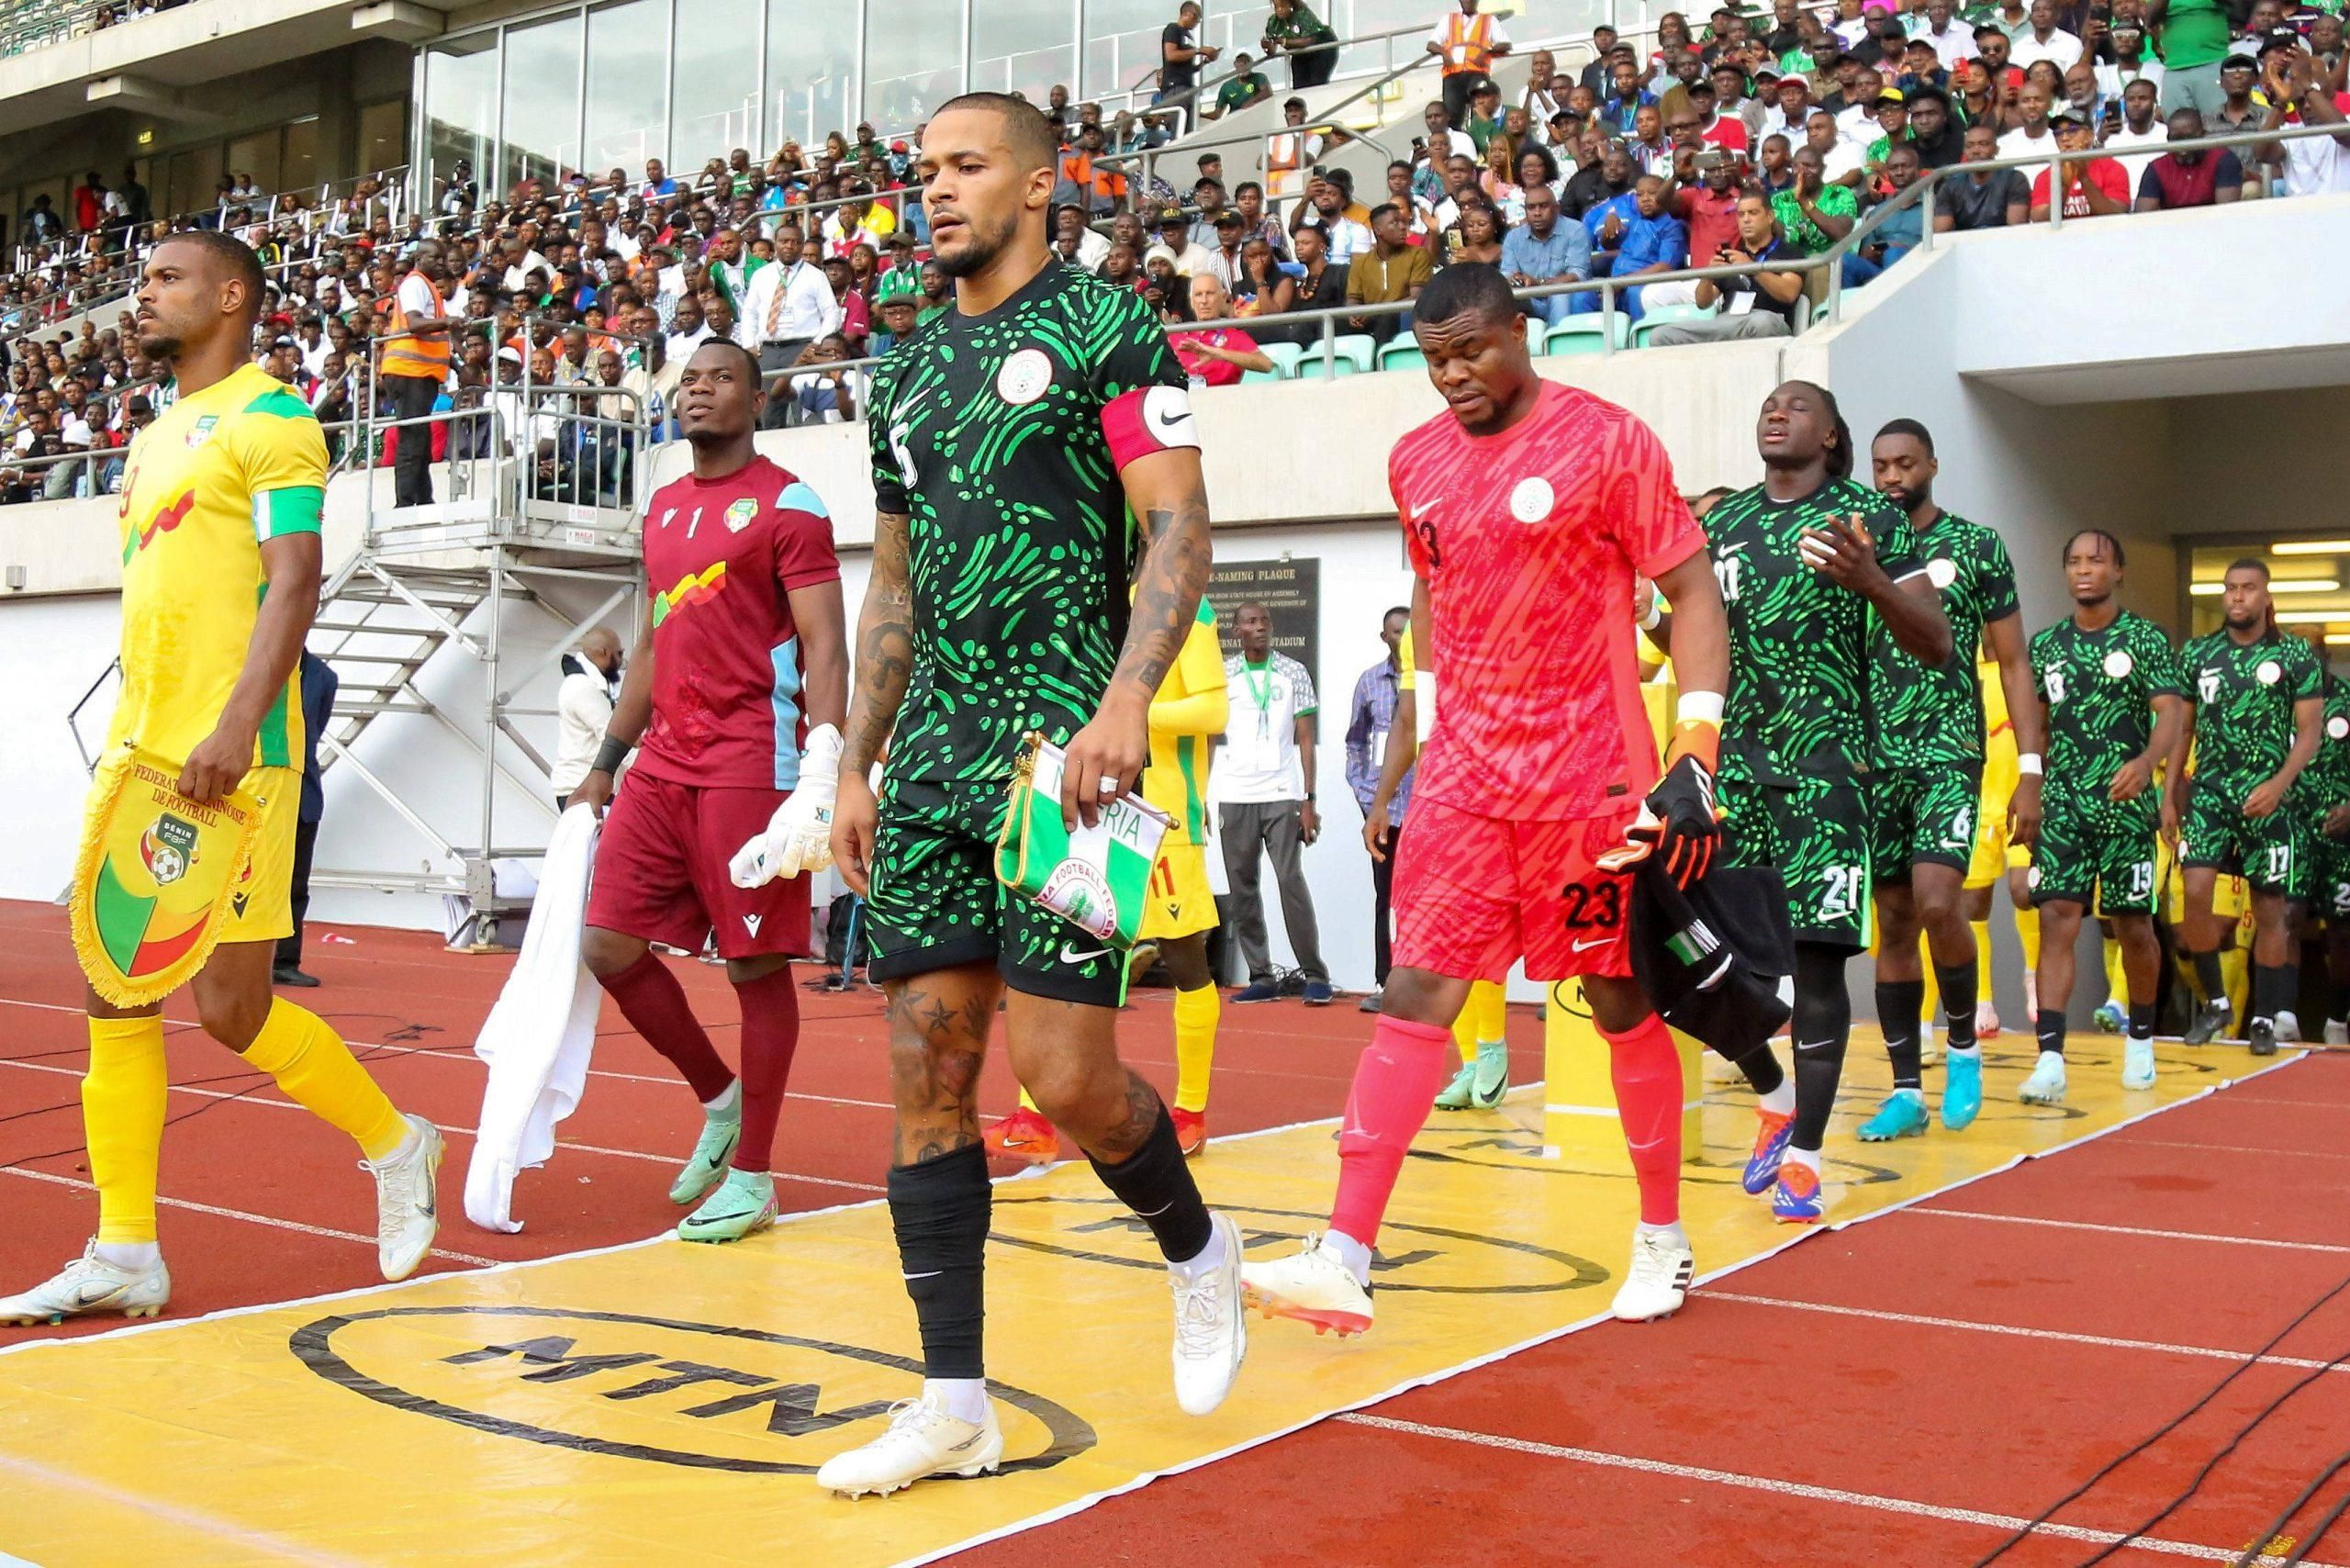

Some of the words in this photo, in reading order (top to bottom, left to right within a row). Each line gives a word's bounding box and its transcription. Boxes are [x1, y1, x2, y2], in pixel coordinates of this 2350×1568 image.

[890, 421, 918, 489] 5
[687, 506, 703, 539] 1
[1208, 570, 1254, 583] E-NAMING
[1259, 568, 1295, 580] PLAQUE
[1713, 556, 1740, 602] 21
[1270, 636, 1305, 646] STADIUM
[2044, 671, 2065, 704] 13
[2198, 676, 2221, 704] 17
[151, 788, 168, 805] DE
[166, 792, 218, 828] FOOTBALL
[1953, 806, 1971, 839] 6
[1056, 863, 1102, 889] FOOTBALL
[2267, 845, 2288, 874] 17
[1823, 865, 1863, 910] 21
[2131, 861, 2153, 892] 13
[1562, 880, 1620, 930] 23
[441, 1336, 906, 1438] MTN
